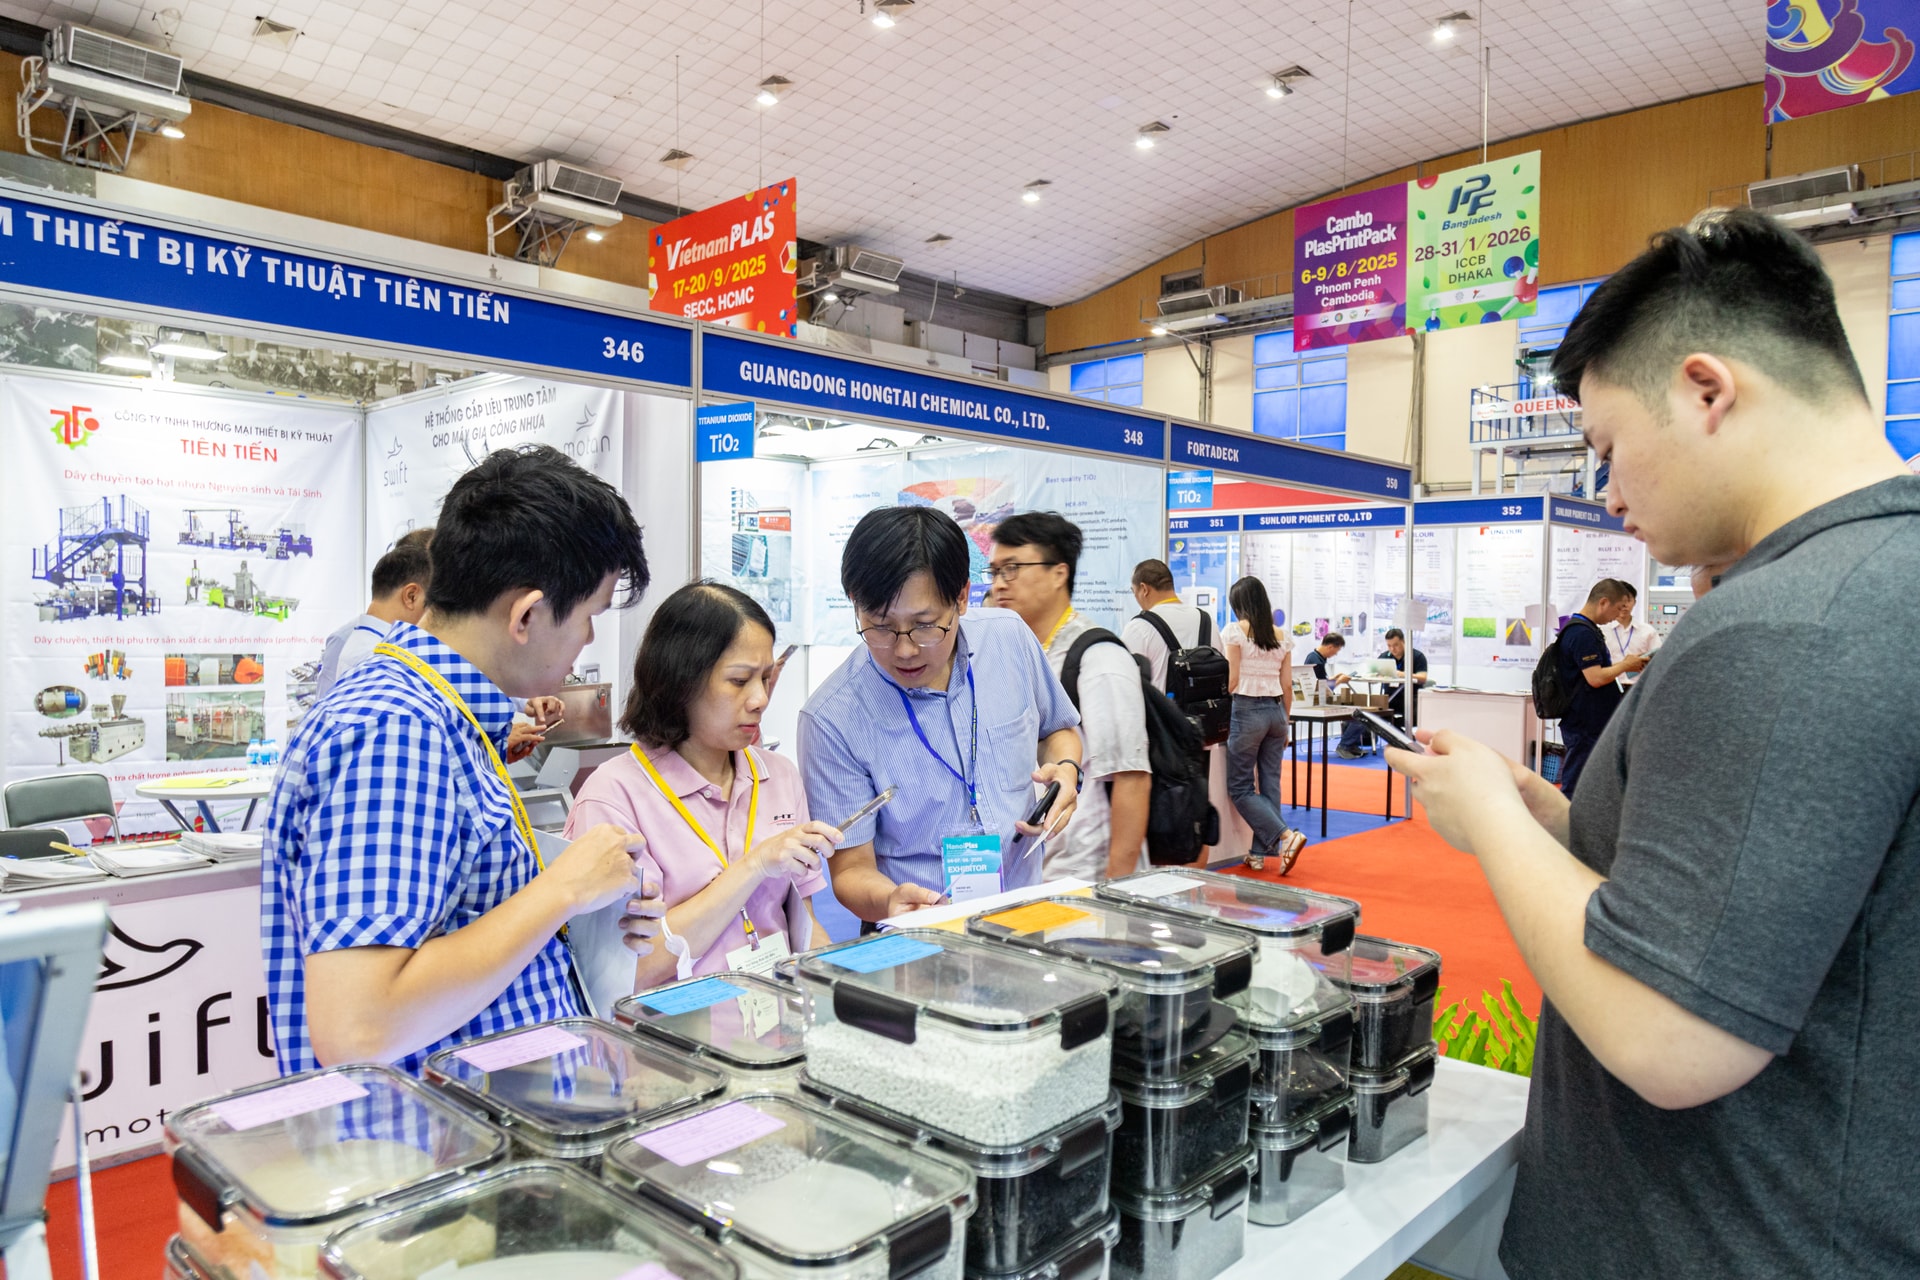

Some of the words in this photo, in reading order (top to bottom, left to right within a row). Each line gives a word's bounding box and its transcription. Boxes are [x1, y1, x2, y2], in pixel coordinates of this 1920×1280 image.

[1326, 210, 1373, 235] Cambo
[1441, 211, 1502, 231] Bangladesh
[1304, 223, 1397, 259] PlasPrintPack
[1414, 225, 1531, 262] 28-31/1/2026
[26, 210, 145, 260] THIẾT
[158, 236, 195, 275] BỊ
[207, 245, 252, 278] KỸ
[262, 256, 366, 300] THUẬT
[374, 277, 441, 313] TIÊN
[448, 290, 510, 325] TIẾN
[1301, 252, 1398, 285] 6-9/8/2025
[1455, 254, 1487, 269] ICCB
[673, 254, 766, 299] 17-20/9/2025
[1315, 280, 1351, 296] Phnom
[1353, 274, 1382, 290] Penh
[1448, 267, 1493, 285] DHAKA
[683, 296, 716, 319] SECC,
[717, 286, 754, 312] HCMC
[1320, 289, 1375, 308] Cambodia
[603, 336, 645, 364] 346
[739, 360, 847, 398] GUANGDONG
[850, 379, 917, 408] HONGTAI
[920, 393, 991, 421] CHEMICAL
[994, 406, 1020, 429] CO.,
[1022, 411, 1050, 431] LTD.
[1514, 398, 1583, 415] QUEENS
[424, 410, 435, 432] HỆ
[435, 404, 464, 427] THỐNG
[465, 398, 483, 420] CẤP
[485, 398, 502, 418] LIỆU
[504, 392, 535, 412] TRUNG
[536, 385, 557, 406] TÂM
[698, 414, 727, 426] TITANIUM
[728, 412, 753, 423] DIOXIDE
[114, 409, 147, 424] CÔNG
[149, 414, 161, 425] TY
[164, 416, 189, 428] TNHH
[192, 419, 232, 433] THƯƠNG
[234, 424, 253, 437] MẠI
[254, 425, 279, 438] THIẾT
[280, 429, 289, 441] BỊ
[304, 431, 334, 445] THUẬT
[432, 431, 450, 448] CHO
[452, 426, 470, 444] MÁY
[489, 419, 518, 438] CÔNG
[519, 413, 546, 434] NHỰA
[1124, 428, 1144, 446] 348
[180, 438, 227, 458] TIÊN
[233, 440, 279, 463] TIẾN
[563, 435, 611, 457] motan
[1187, 440, 1240, 463] FORTADECK
[64, 468, 87, 482] Dây
[135, 476, 154, 486] tạo
[156, 477, 174, 488] hạt
[251, 485, 272, 495] sinh
[274, 487, 286, 496] và
[287, 487, 301, 497] Tái
[303, 488, 323, 498] Sinh
[383, 460, 408, 487] swift
[1045, 476, 1060, 484] Best
[1386, 476, 1398, 490] 350
[1260, 515, 1298, 526] SUNLOUR
[1298, 513, 1336, 524] PIGMENT
[1337, 511, 1373, 523] CO.,LTD
[1502, 505, 1522, 516] 352
[1169, 520, 1189, 529] ATER
[1209, 518, 1225, 528] 351
[34, 635, 52, 645] Dây
[947, 864, 987, 873] EXHIBITOR
[85, 1108, 173, 1146] mot
